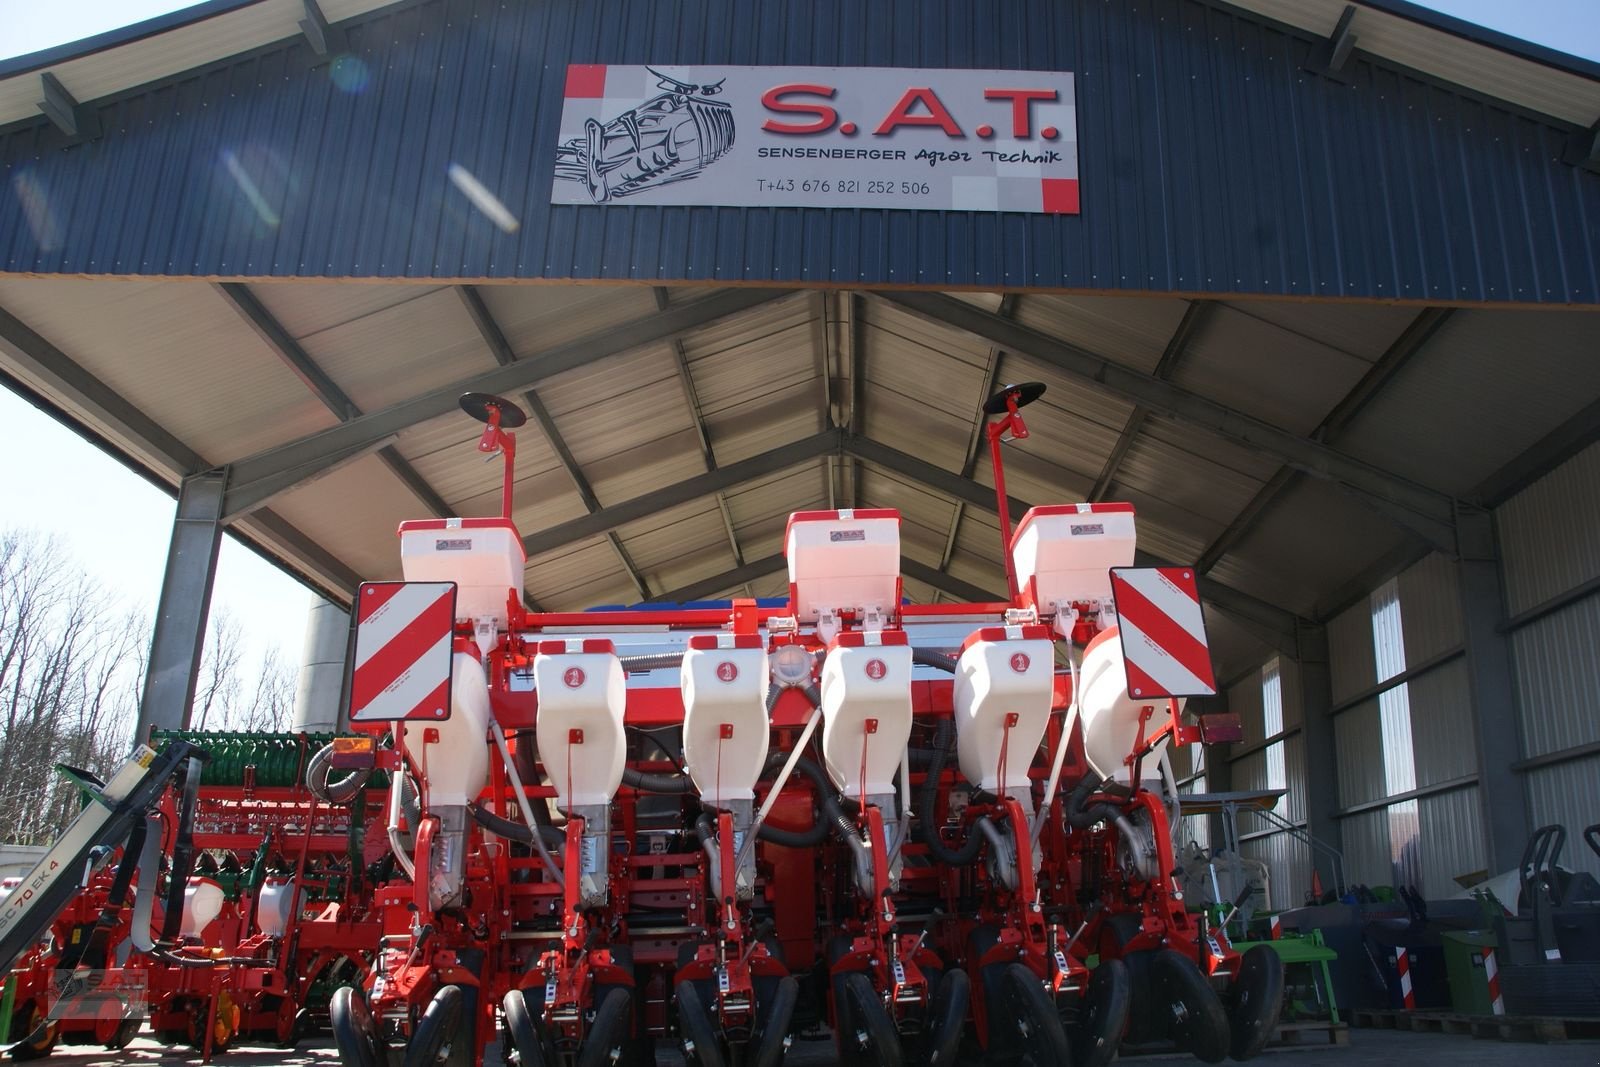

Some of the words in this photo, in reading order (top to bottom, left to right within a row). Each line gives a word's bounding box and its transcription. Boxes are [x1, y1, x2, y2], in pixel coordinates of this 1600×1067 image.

[761, 83, 1059, 138] S.A.T.
[758, 148, 906, 160] SENSENBERGER
[914, 149, 972, 167] Agrar
[982, 150, 1062, 164] Technik
[757, 179, 795, 192] T+43
[802, 180, 830, 192] 676
[837, 181, 860, 193] 821
[867, 181, 894, 194] 252
[901, 182, 930, 194] 506
[14, 889, 33, 907] 70
[31, 871, 50, 889] EK
[49, 860, 59, 870] 4
